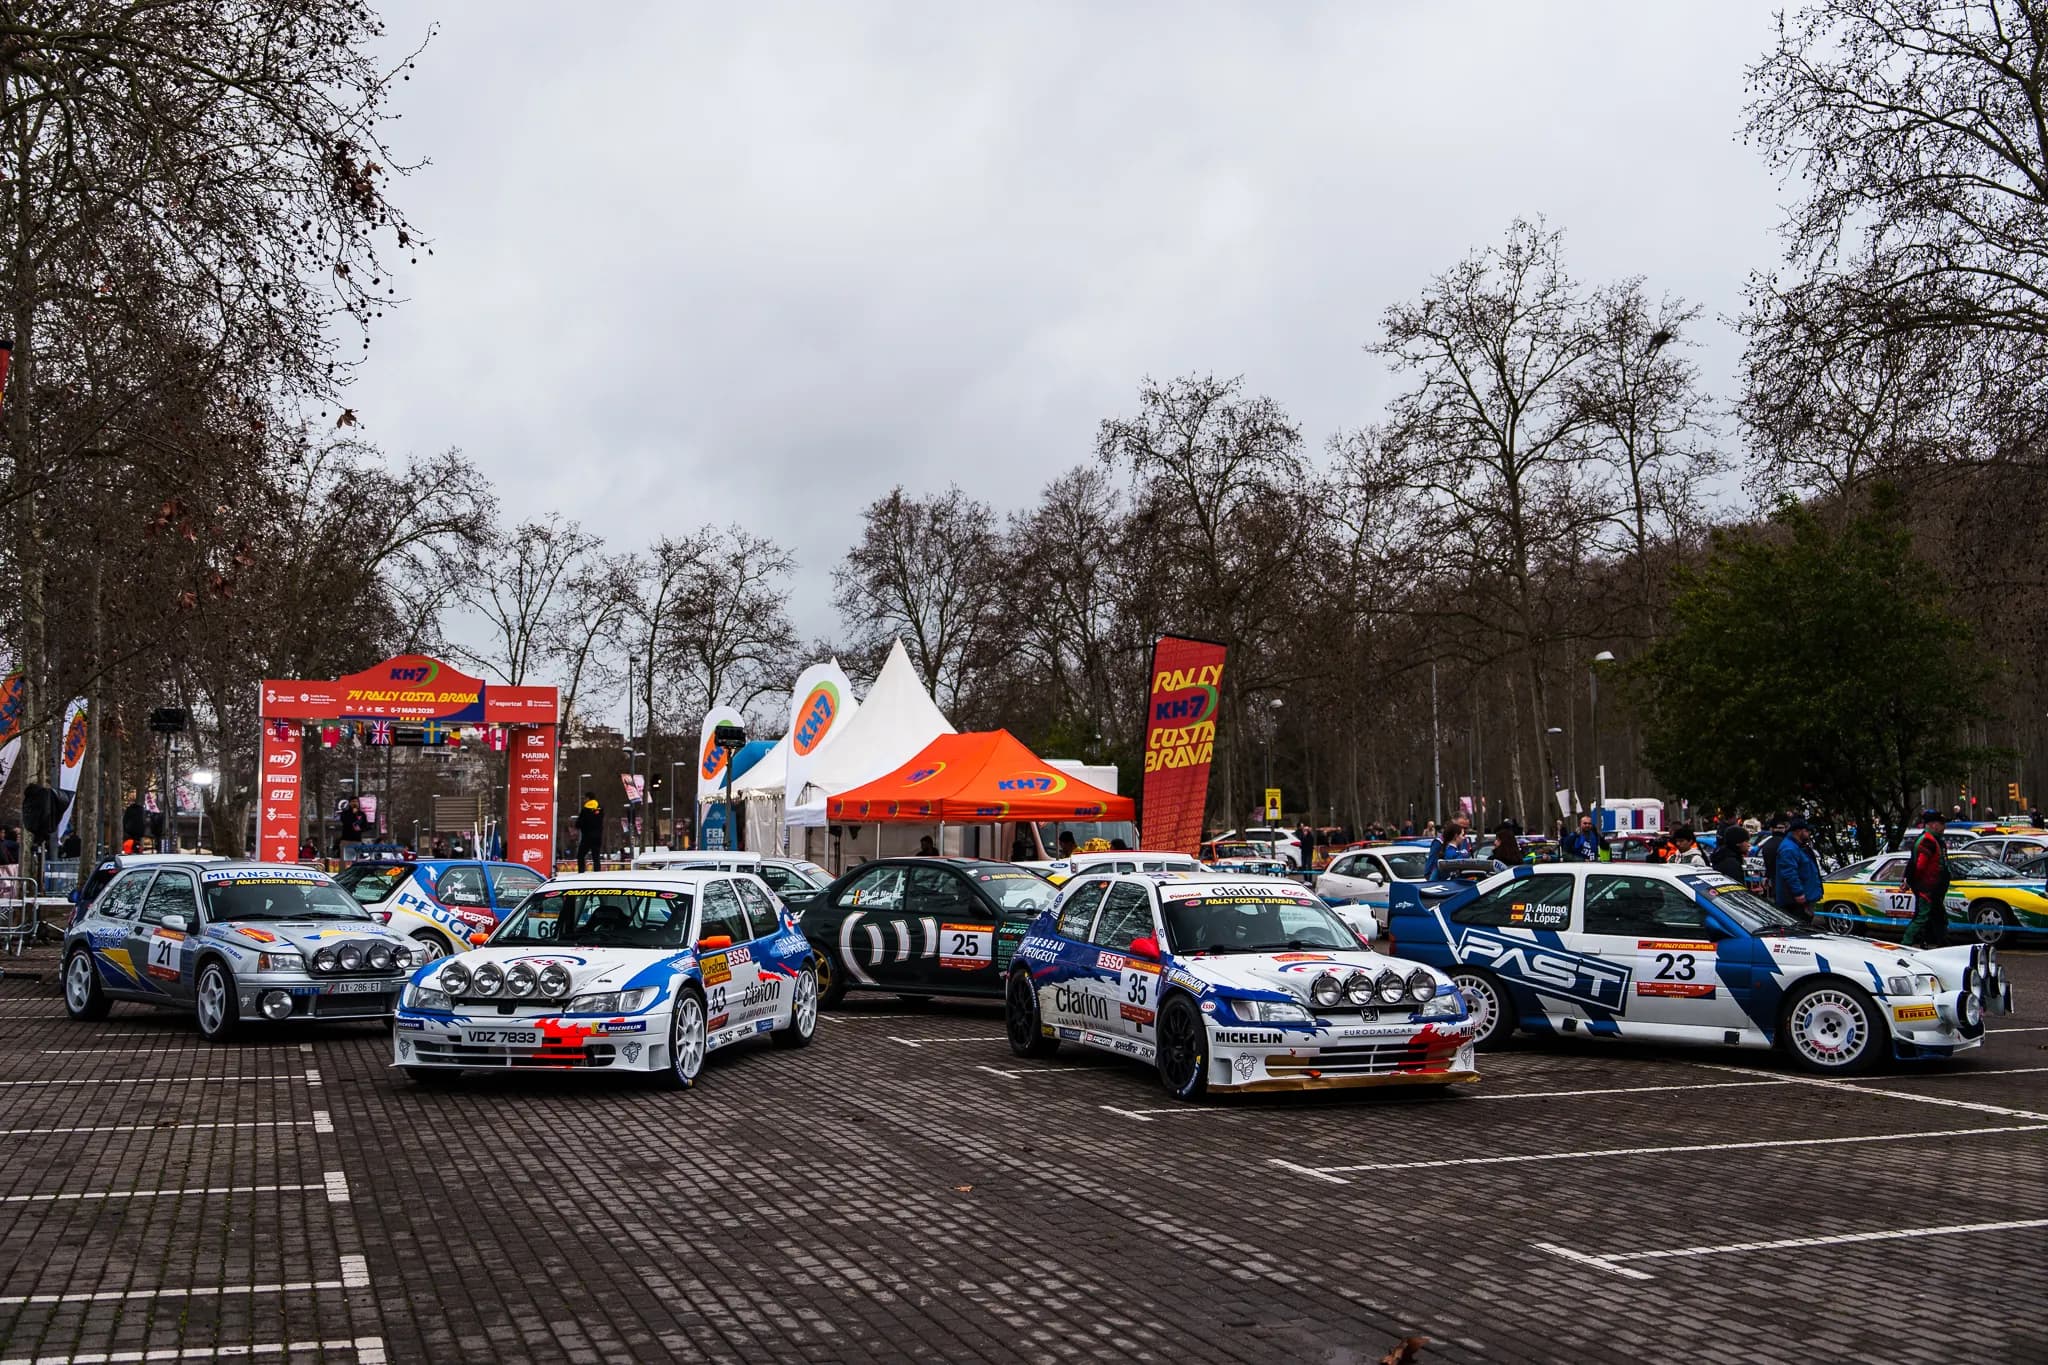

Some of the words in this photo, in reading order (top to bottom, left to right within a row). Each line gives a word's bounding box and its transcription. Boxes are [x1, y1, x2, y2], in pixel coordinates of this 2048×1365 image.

[1153, 664, 1224, 694] RALLY
[347, 690, 361, 700] 74
[362, 690, 400, 701] RALLY
[400, 691, 435, 702] COSTA
[438, 692, 479, 703] BRAVA
[267, 728, 300, 737] GINA
[1150, 720, 1216, 749] COSTA
[1144, 742, 1215, 773] BRAVA
[207, 871, 269, 880] MILANO
[273, 871, 329, 881] RACING
[1526, 903, 1534, 912] D.
[1536, 904, 1567, 913] Alonso
[1890, 895, 1912, 910] 127
[398, 893, 475, 944] PEUGE
[1524, 914, 1533, 922] A.
[1534, 913, 1560, 924] López
[157, 940, 172, 966] 21
[952, 933, 979, 956] 25
[727, 948, 752, 966] ESSO
[1023, 946, 1059, 964] PEUGEOT
[1098, 954, 1124, 970] ESSO
[1461, 935, 1621, 997] PAST
[1655, 953, 1696, 981] 23
[1128, 973, 1148, 1005] 35
[709, 986, 727, 1014] 43
[1898, 1006, 1937, 1019] PIRELL
[468, 1031, 496, 1042] VDZ
[499, 1032, 537, 1043] 7833
[1215, 1032, 1283, 1044] MICHELIN
[1344, 1027, 1413, 1036] EURODATACAR
